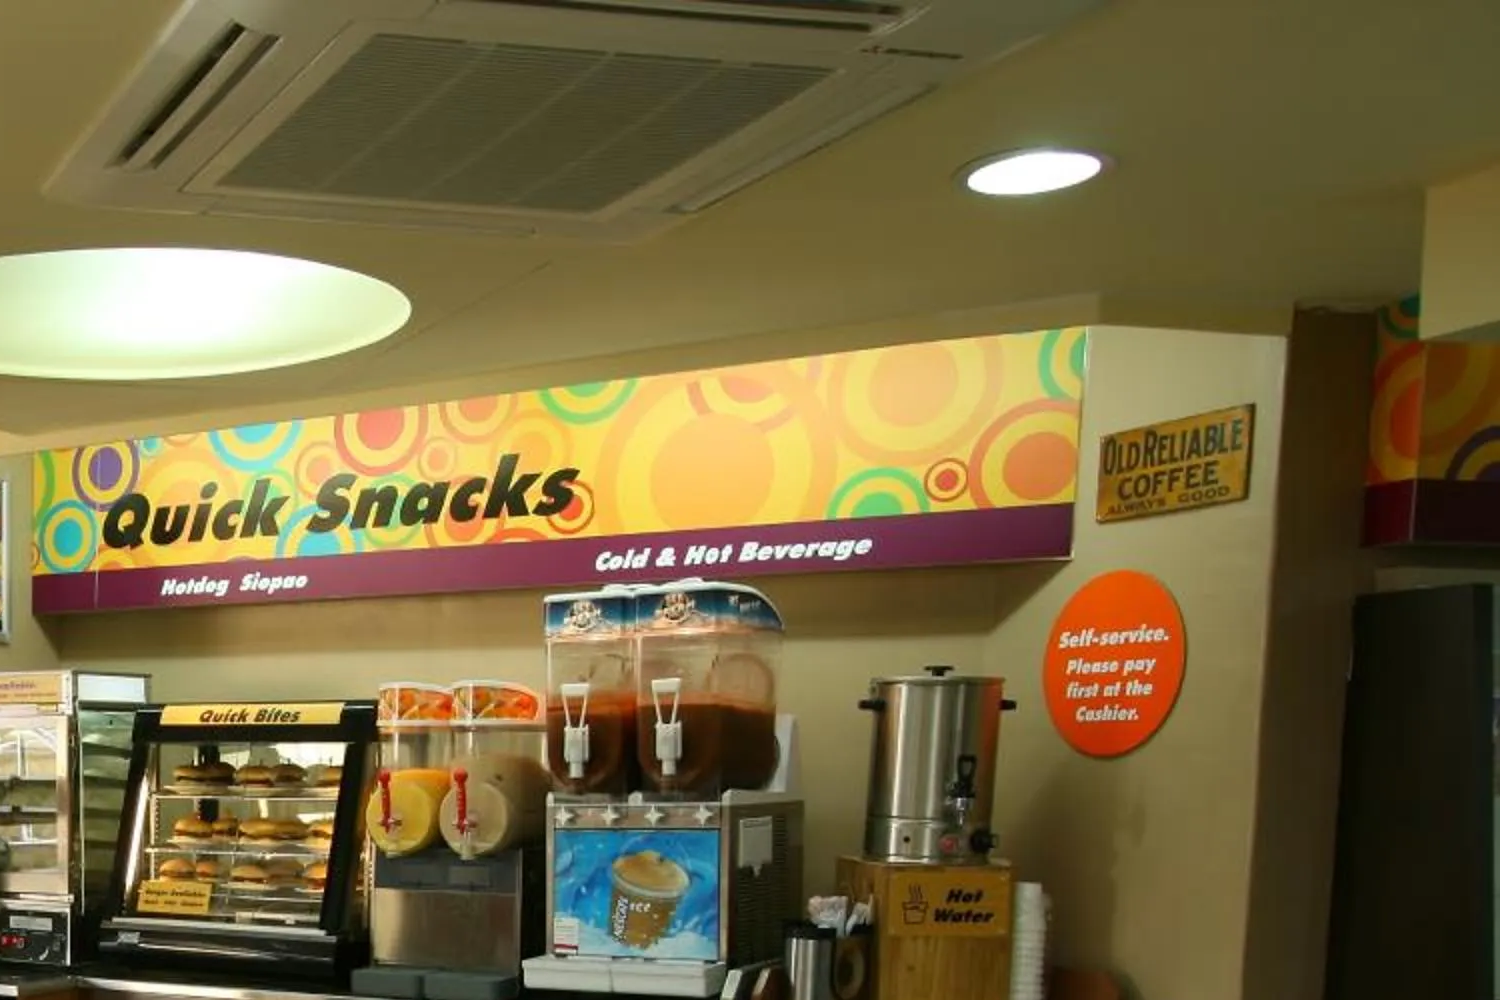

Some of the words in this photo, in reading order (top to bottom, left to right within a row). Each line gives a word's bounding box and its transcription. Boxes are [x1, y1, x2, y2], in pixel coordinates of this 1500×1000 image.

[1103, 437, 1141, 476] OLD
[1142, 418, 1243, 469] RELIABLE
[1117, 460, 1219, 501] COFFEE
[102, 479, 291, 550] Quick
[307, 453, 581, 534] Snacks
[1176, 485, 1231, 503] GOOD
[594, 548, 652, 571] Cold
[655, 547, 676, 567] &
[683, 544, 733, 566] Hot
[737, 538, 874, 563] Beverage
[160, 575, 231, 597] Hotdog
[239, 571, 309, 595] Siopao
[1058, 624, 1170, 649] Self-service.
[1065, 657, 1119, 676] Please
[1122, 658, 1157, 677] pay
[1066, 681, 1099, 699] first
[1103, 681, 1121, 697] at
[1125, 679, 1153, 696] the
[199, 708, 250, 723] Quick
[253, 707, 302, 723] Bites
[1075, 703, 1140, 722] Cashier.
[946, 888, 984, 904] Hot
[933, 907, 995, 923] Water
